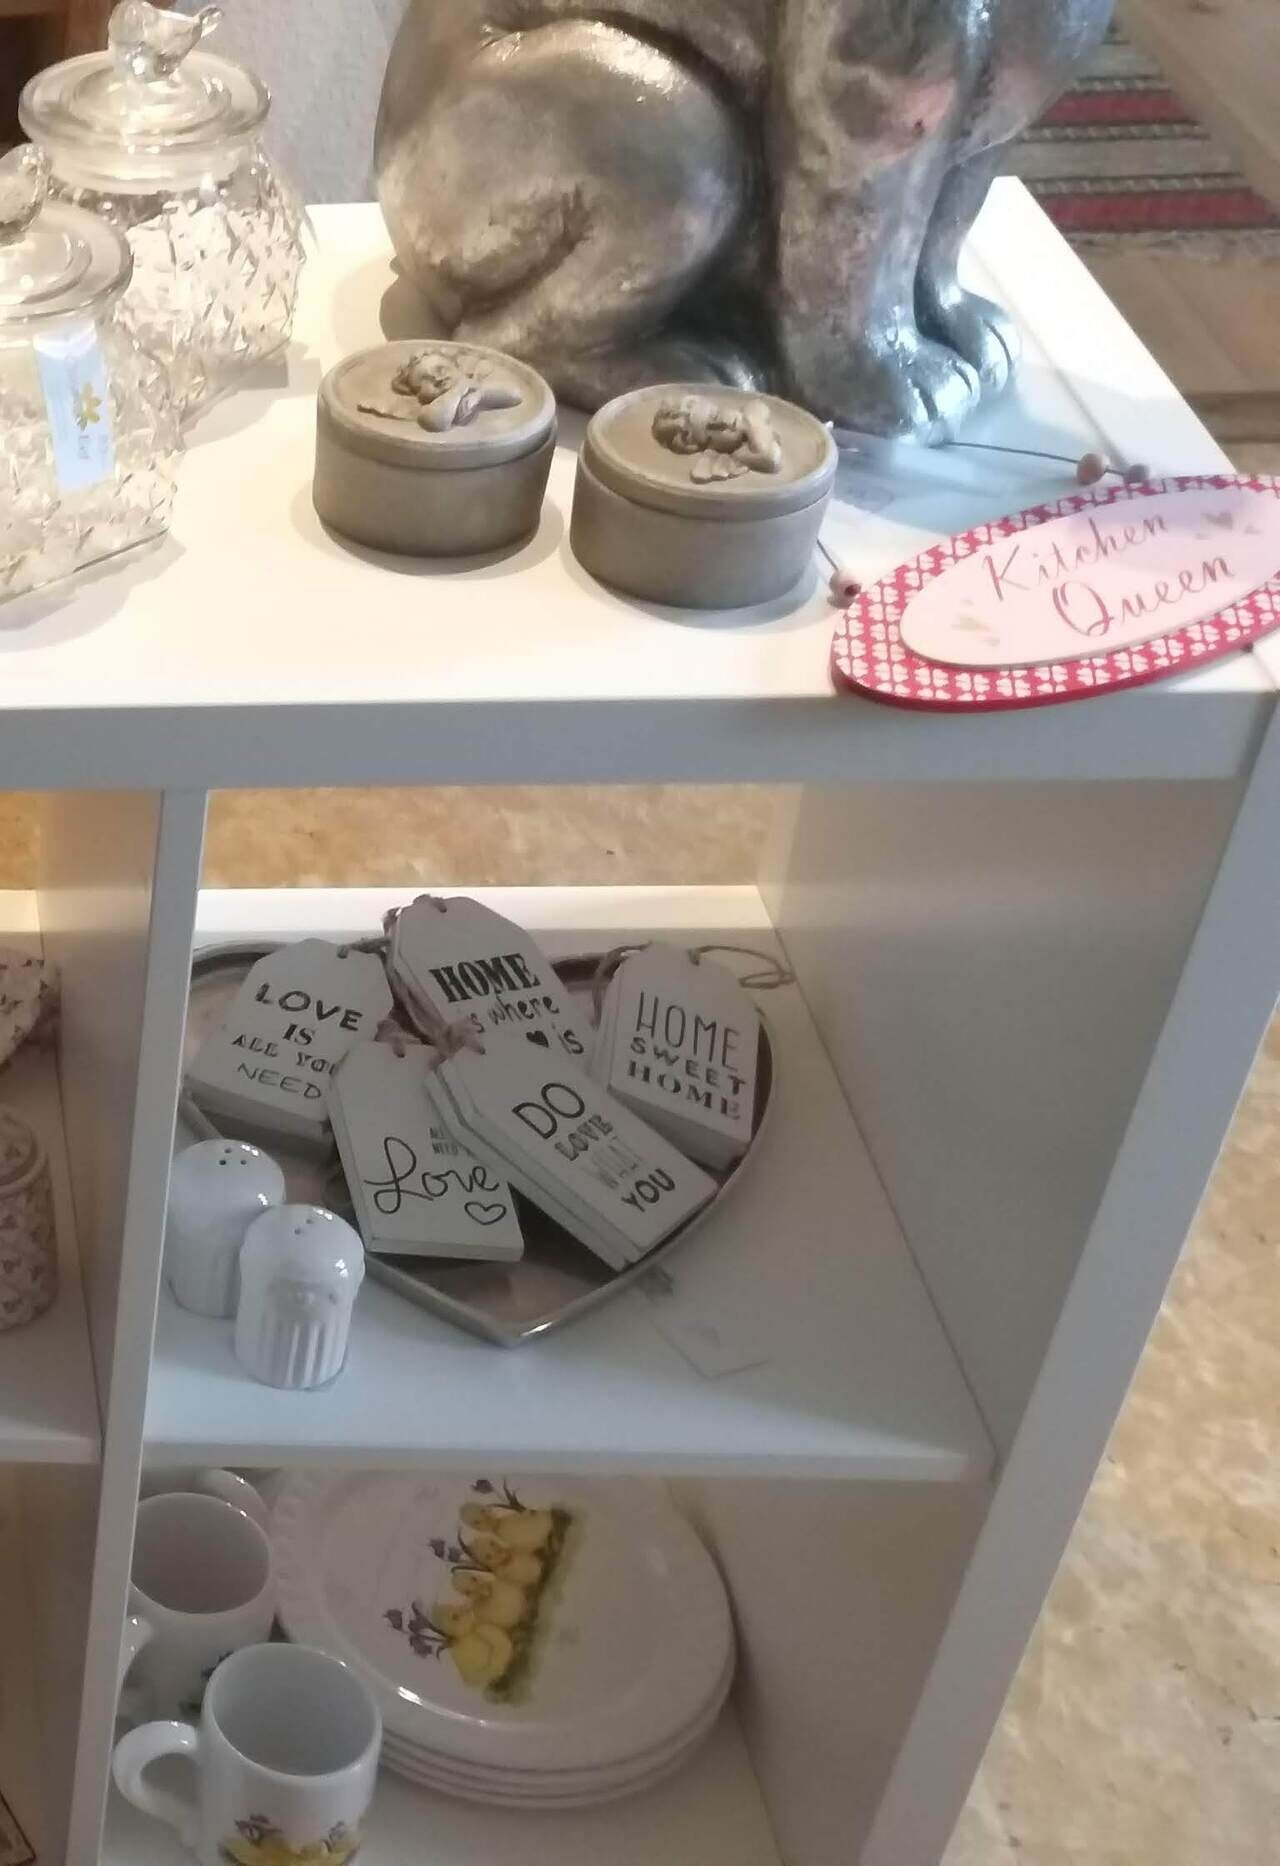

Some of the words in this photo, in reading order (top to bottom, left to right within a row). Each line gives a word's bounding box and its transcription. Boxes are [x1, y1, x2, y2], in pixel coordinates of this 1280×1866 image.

[983, 514, 1167, 602] Kitchen
[1051, 556, 1234, 637] Queen
[428, 952, 541, 1003] HOME
[254, 982, 364, 1032] LOVE
[488, 993, 560, 1026] where
[636, 990, 741, 1073] HOME
[231, 1033, 280, 1058] ALL
[282, 1023, 316, 1046] IS
[550, 1021, 585, 1055] is
[237, 1061, 323, 1100] NEED
[627, 1059, 742, 1121] HOME
[630, 1035, 746, 1096] SWEET
[511, 1081, 586, 1140] DO
[554, 1114, 614, 1162] LOVE
[363, 1135, 500, 1215] Love
[620, 1167, 676, 1213] YOU
